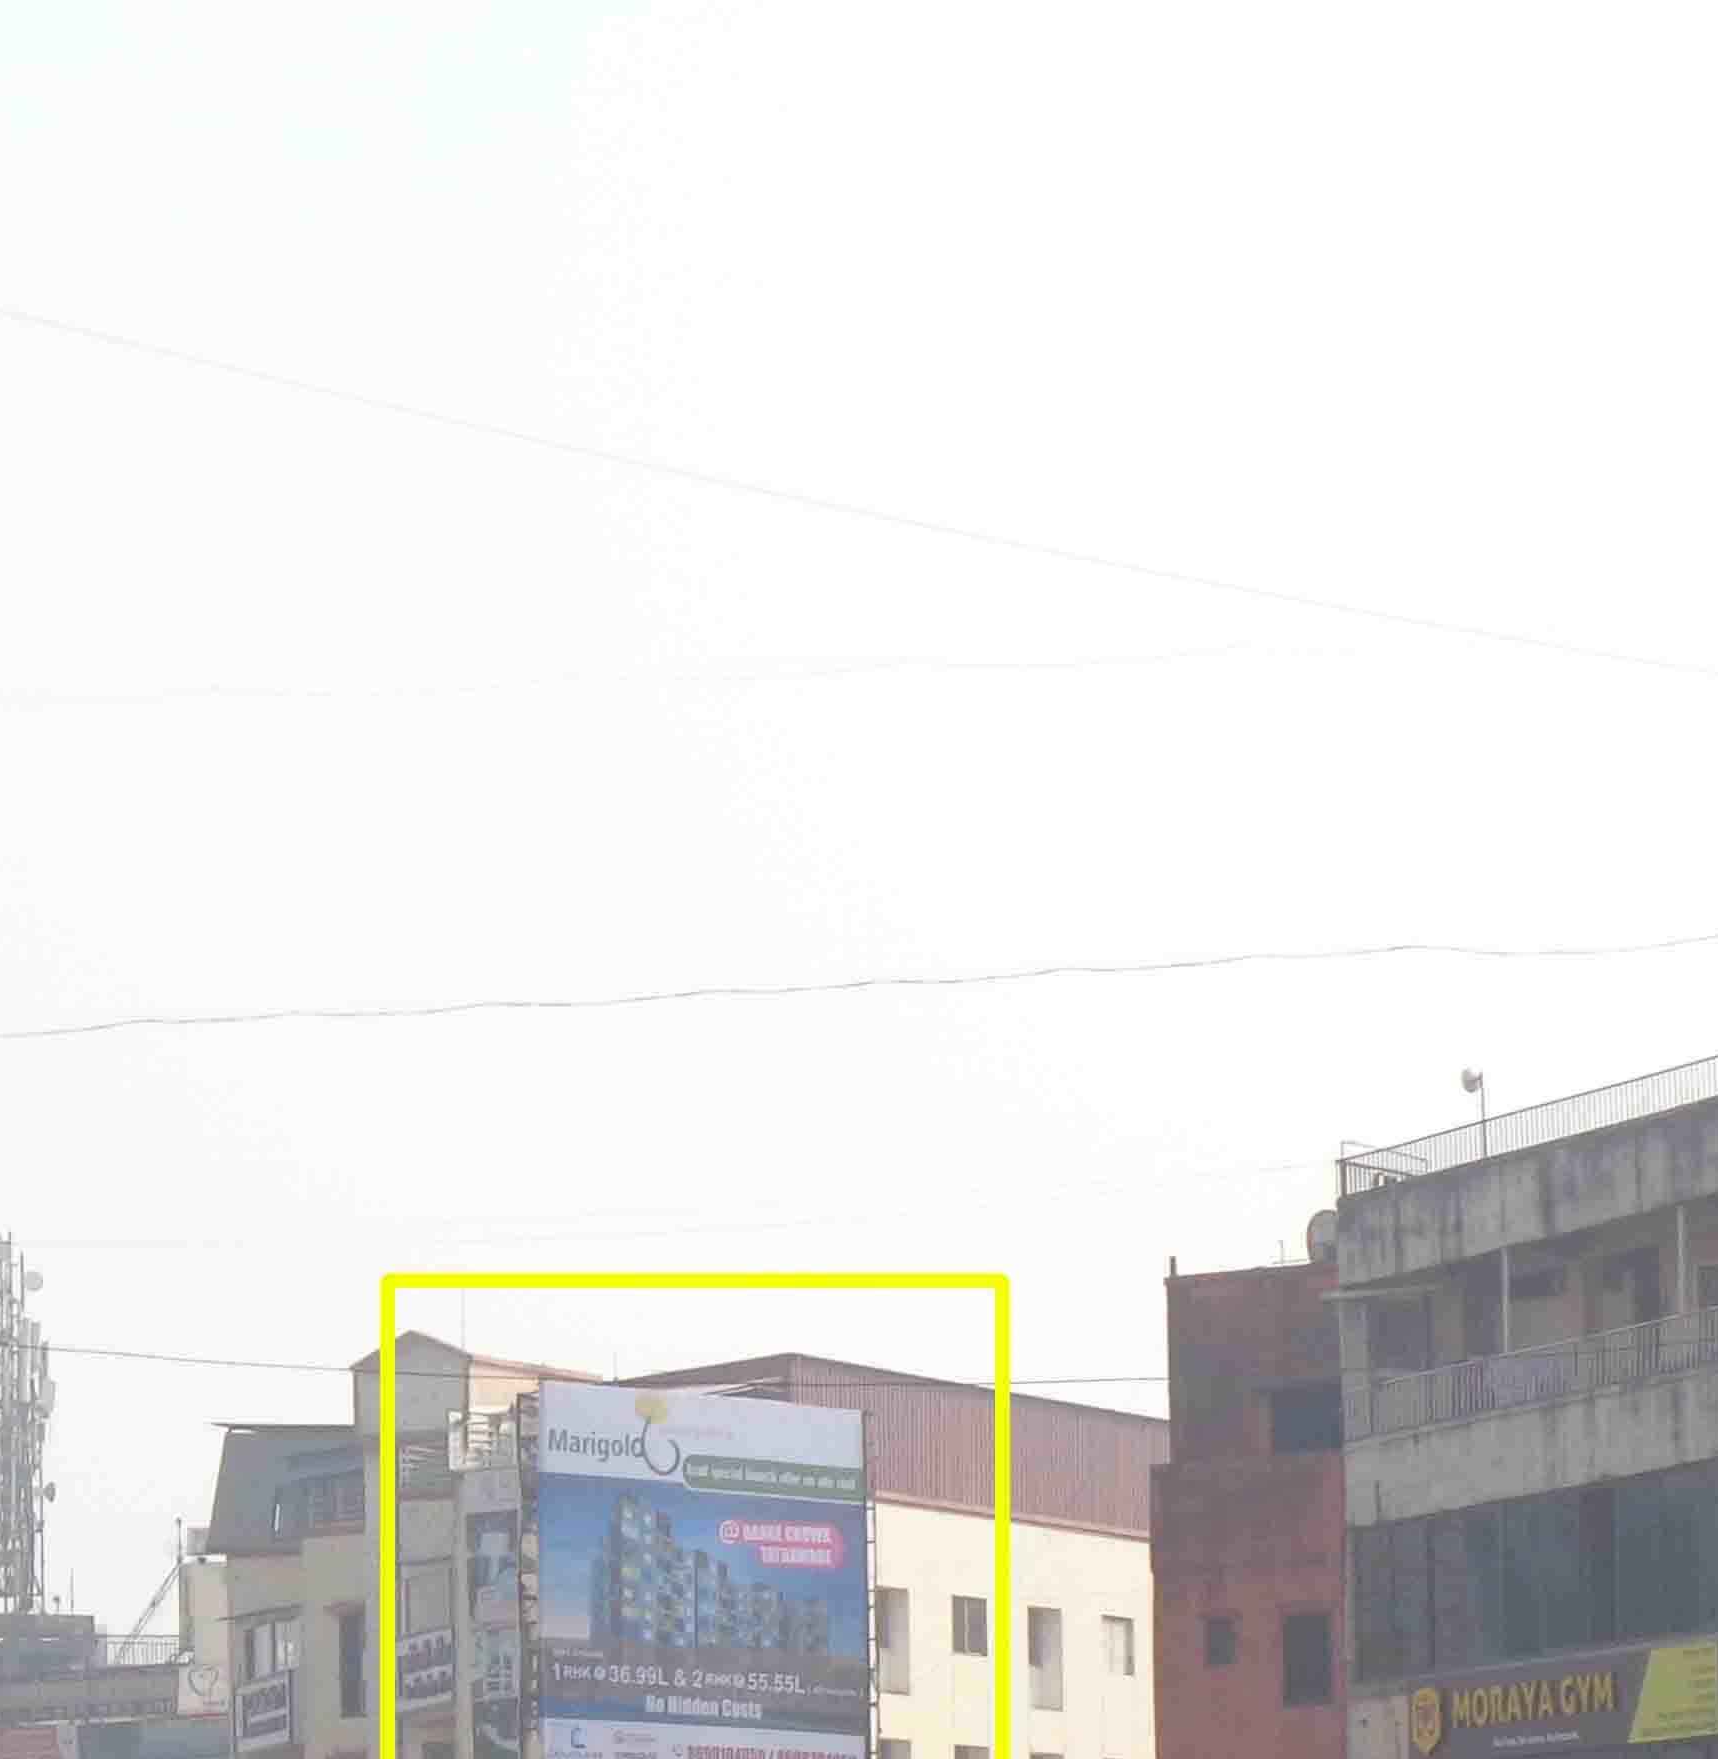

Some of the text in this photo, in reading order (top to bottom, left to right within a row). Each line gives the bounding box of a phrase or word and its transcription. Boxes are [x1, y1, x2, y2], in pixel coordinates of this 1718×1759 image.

[547, 1427, 644, 1462] Marigold
[1450, 1671, 1618, 1729] MORAYA GYM
